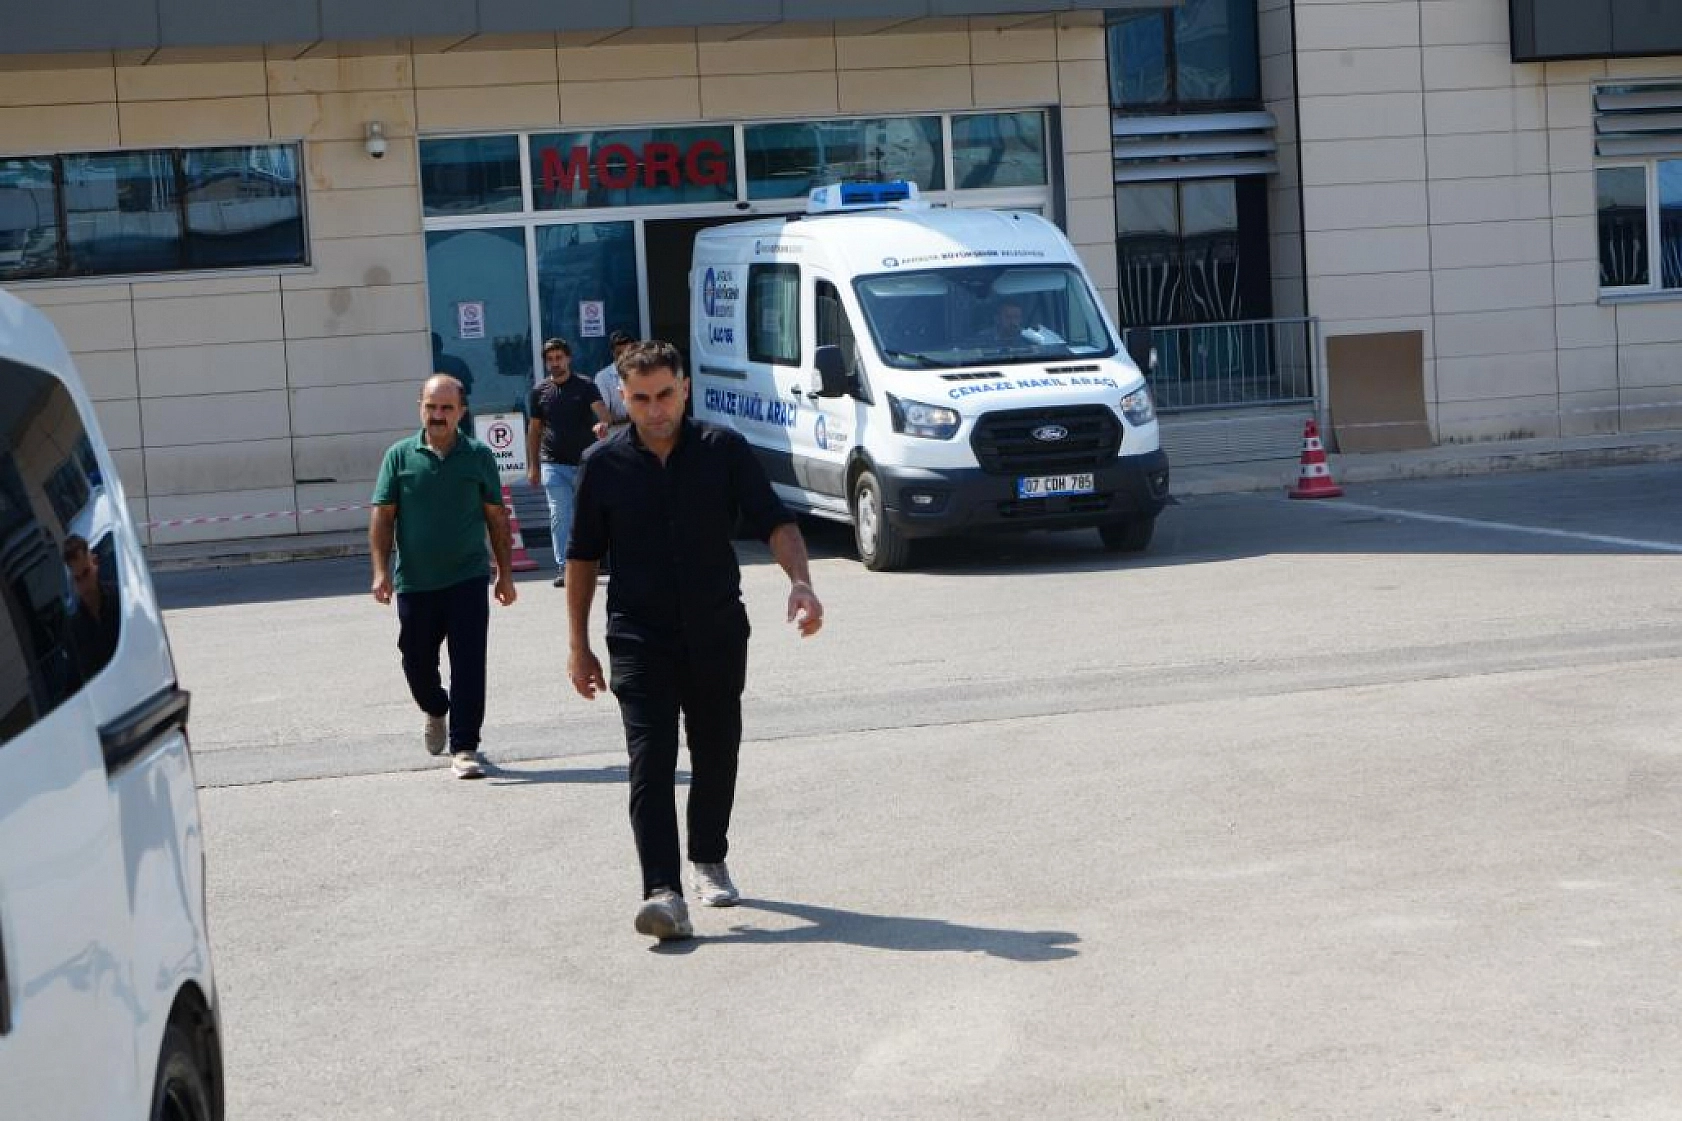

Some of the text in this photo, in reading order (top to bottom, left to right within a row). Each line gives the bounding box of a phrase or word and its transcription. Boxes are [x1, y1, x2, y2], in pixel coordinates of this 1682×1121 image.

[539, 140, 728, 193] MORG
[949, 381, 1015, 399] CENAZE
[705, 387, 737, 416] CENAZE
[766, 401, 796, 428] ARACI
[1026, 480, 1039, 493] 07
